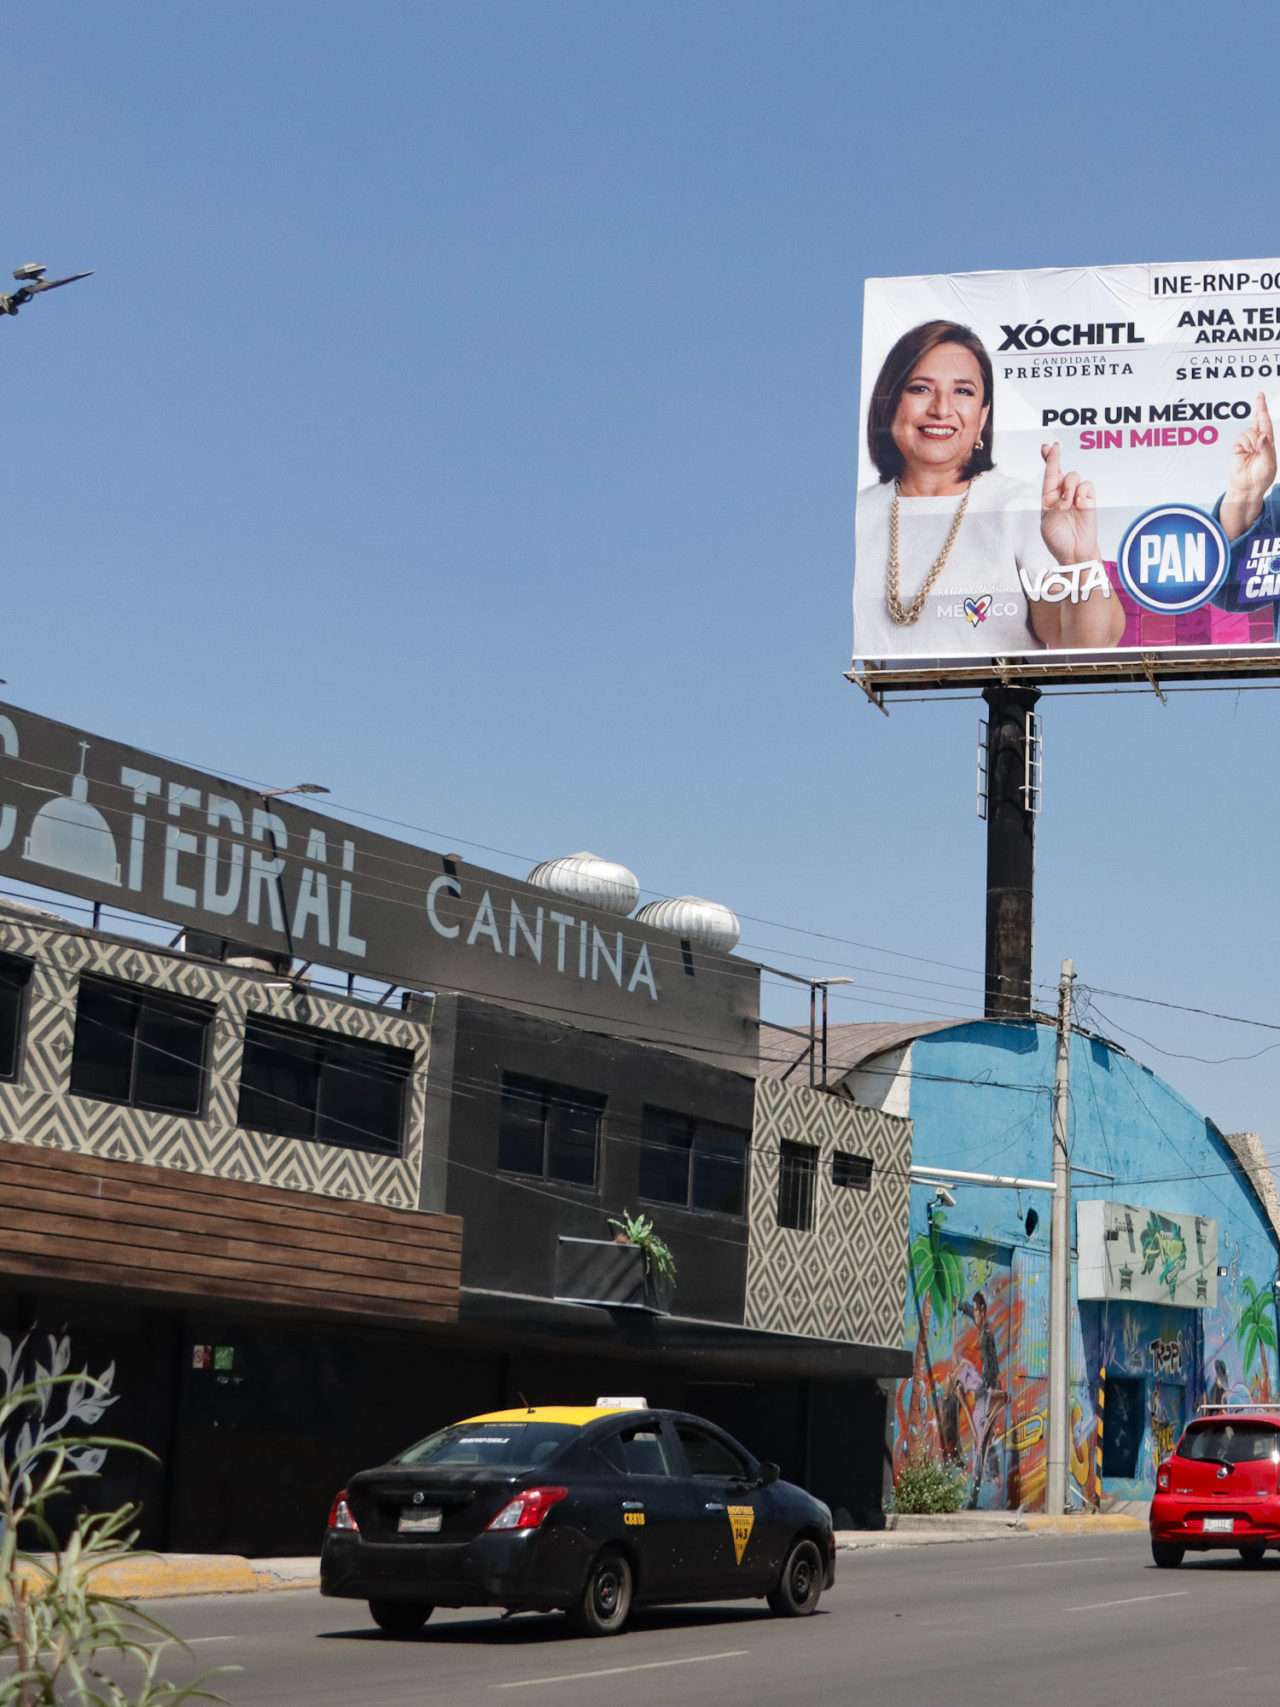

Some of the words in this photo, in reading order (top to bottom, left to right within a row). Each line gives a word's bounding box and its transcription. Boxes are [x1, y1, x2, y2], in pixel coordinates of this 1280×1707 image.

[1177, 308, 1235, 328] ANA
[997, 318, 1145, 351] XÓCHITL
[1004, 363, 1134, 379] PRESIDENTA
[1033, 355, 1107, 366] CANDIDATA
[1042, 407, 1098, 426] POR
[1104, 406, 1142, 425] UN
[1149, 398, 1252, 422] MÉXICO
[1079, 429, 1123, 450] SIN
[1130, 425, 1219, 448] MIEDO
[1139, 532, 1206, 584] PAN
[1246, 560, 1258, 569] LA
[1019, 560, 1111, 604] VOTA
[426, 875, 658, 1001] CANTINA
